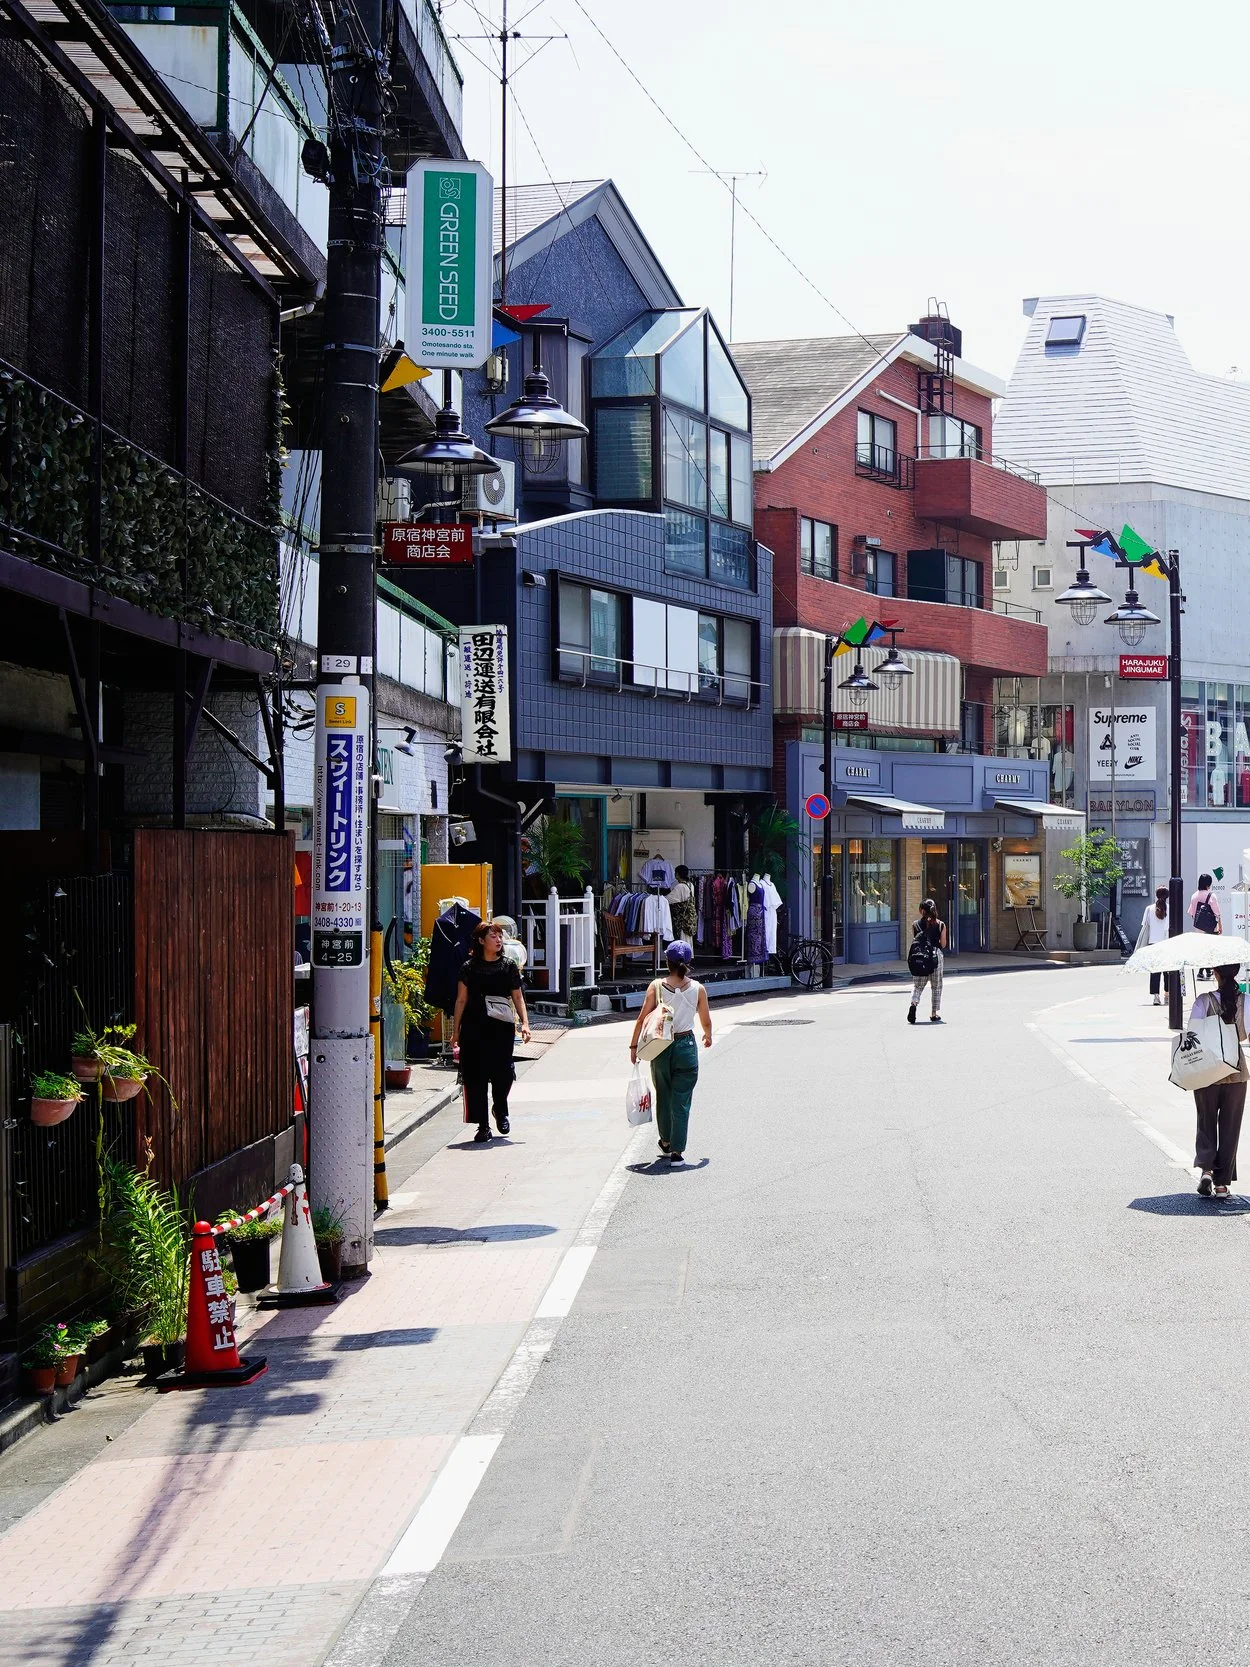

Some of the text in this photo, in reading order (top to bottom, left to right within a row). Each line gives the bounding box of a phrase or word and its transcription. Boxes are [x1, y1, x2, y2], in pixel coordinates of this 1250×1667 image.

[439, 202, 459, 320] GREEN SEED
[422, 328, 475, 338] 3400-5511
[421, 341, 462, 349] Omotesando
[391, 528, 465, 542] 原宿神宮前
[406, 544, 451, 558] 商店会
[335, 658, 351, 668] 29
[1122, 659, 1165, 667] HARAJUKU
[1123, 666, 1163, 674] JINGUMAE
[472, 632, 499, 757] 田辺運送有限会社
[1093, 711, 1147, 727] Supreme
[329, 740, 349, 887] スウィートリンク
[315, 765, 324, 891] http://www.sweet-link.com
[315, 902, 361, 912] 神宮前1-20-13
[314, 917, 353, 927] 3408-4330
[321, 939, 354, 950] 神宮前
[321, 952, 353, 962] 4-25
[201, 1248, 234, 1351] 駐車禁止
